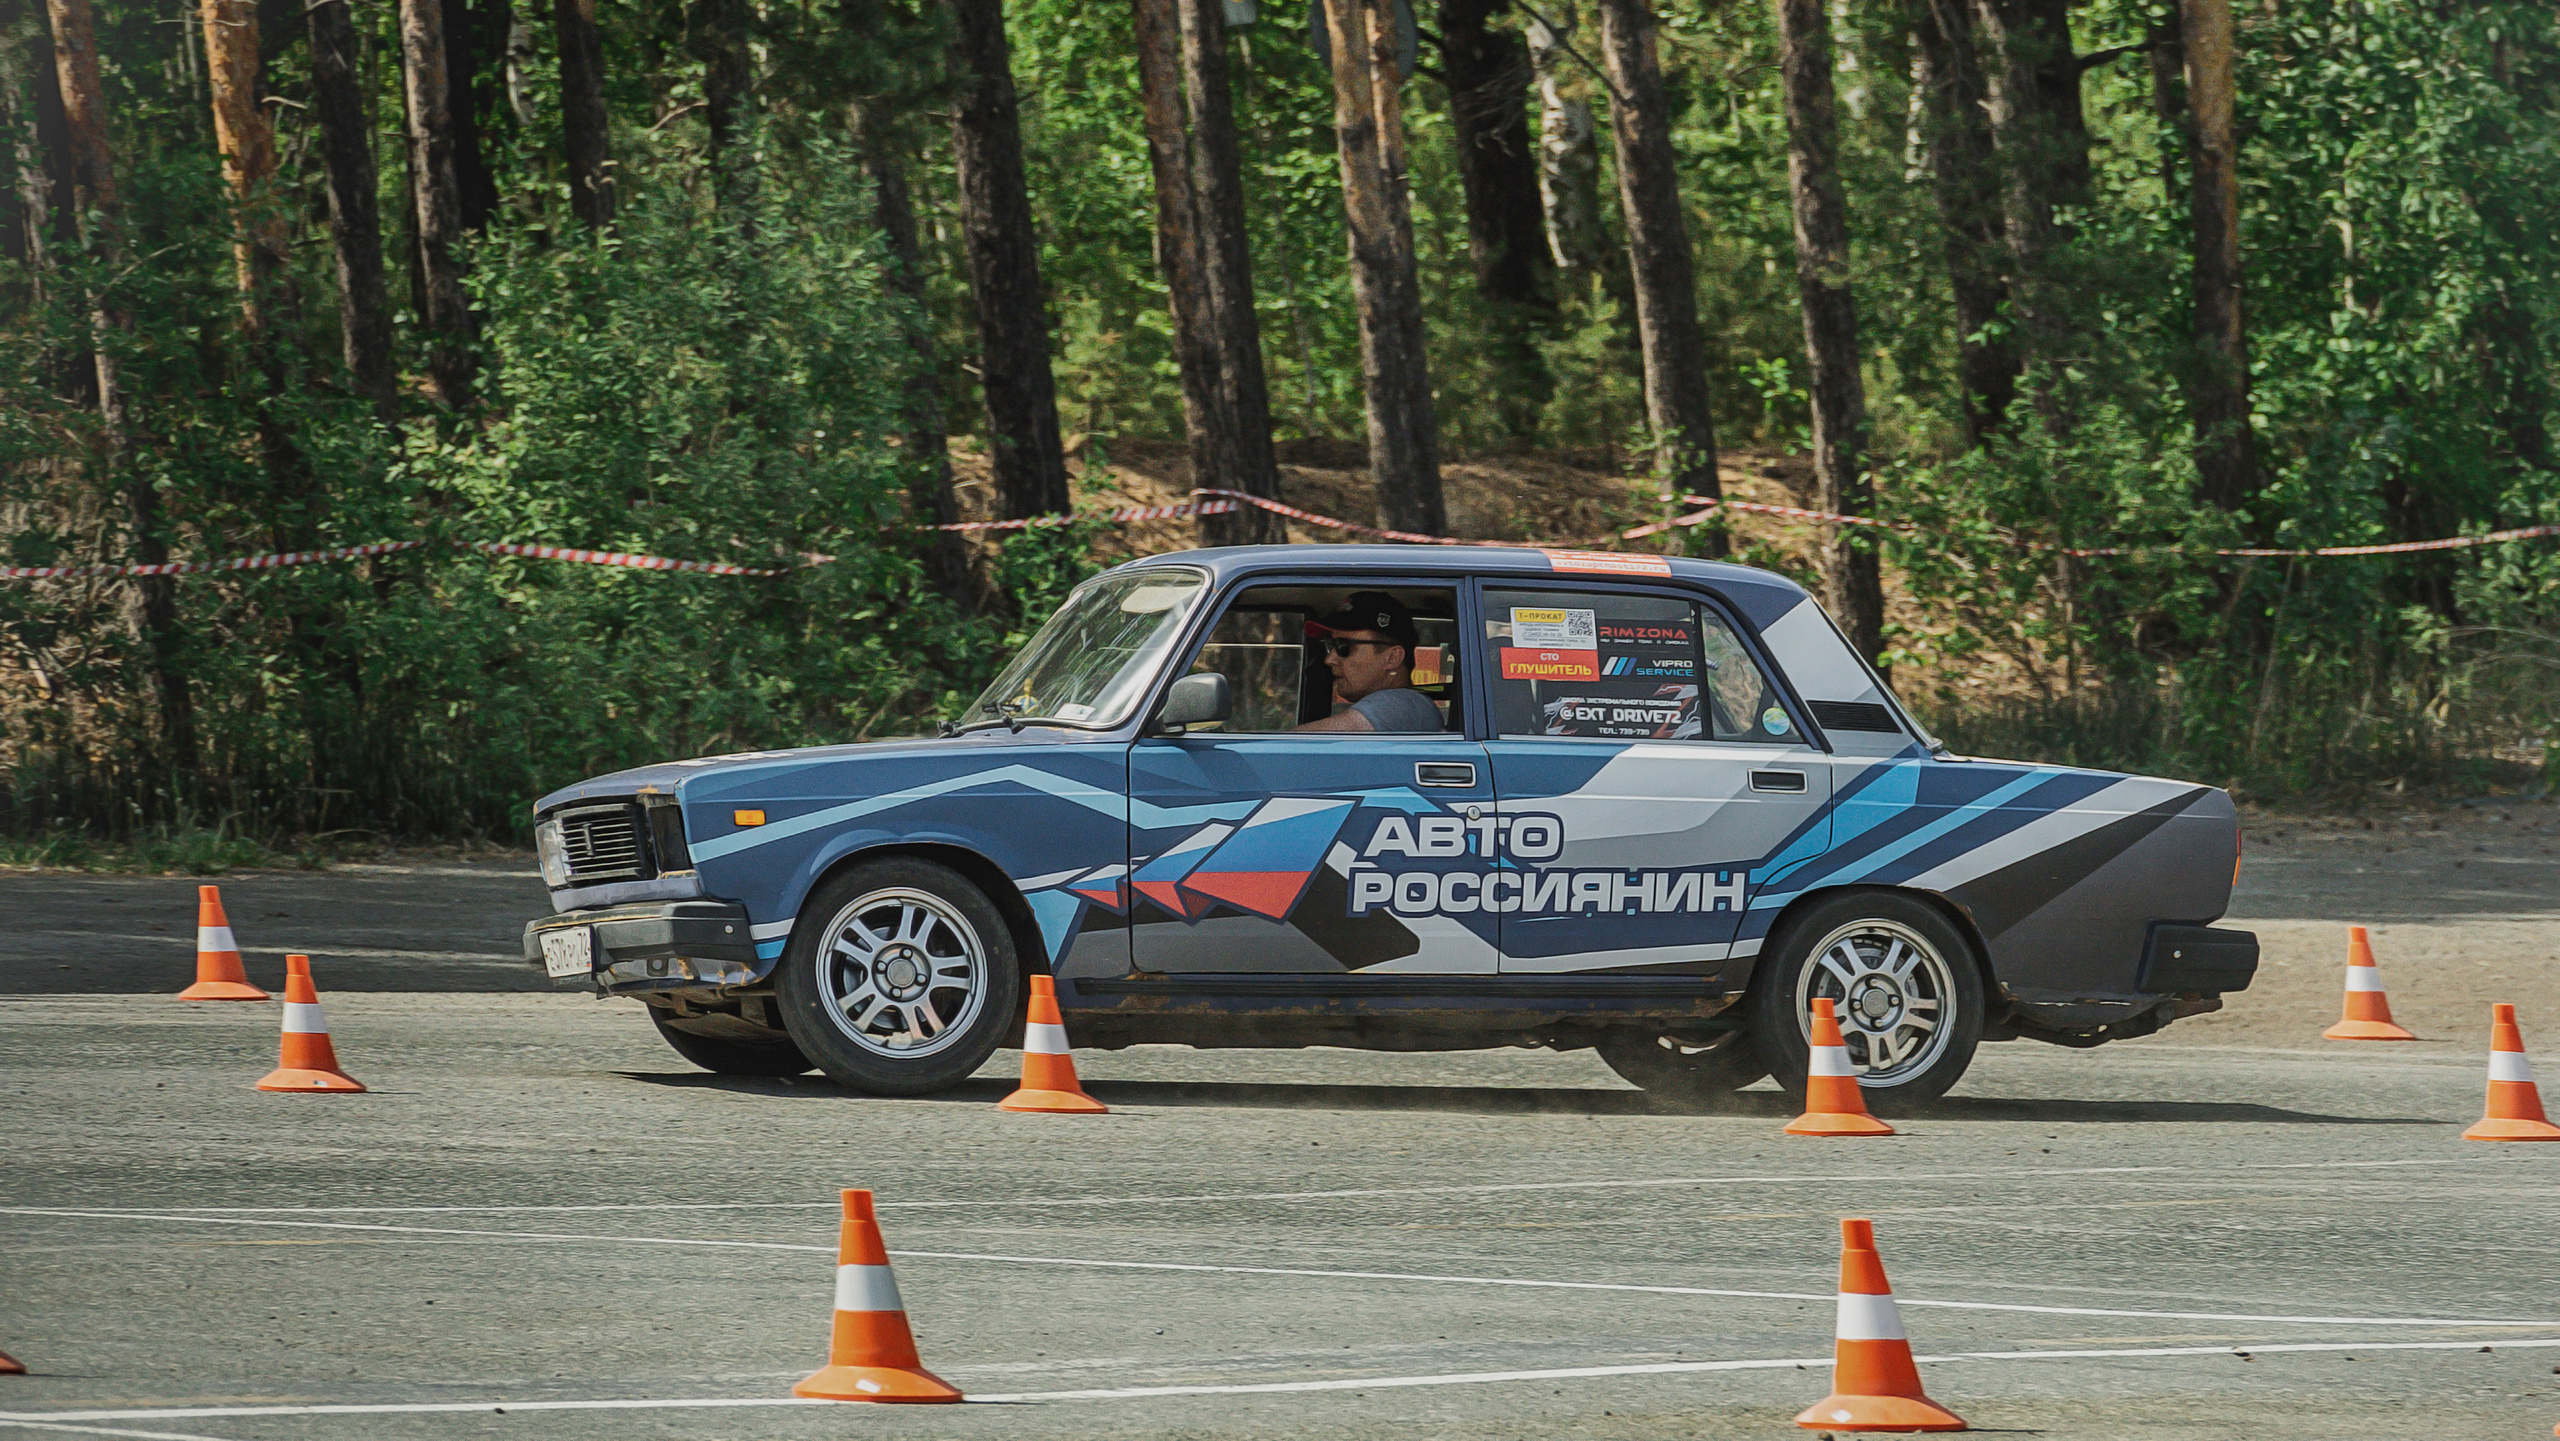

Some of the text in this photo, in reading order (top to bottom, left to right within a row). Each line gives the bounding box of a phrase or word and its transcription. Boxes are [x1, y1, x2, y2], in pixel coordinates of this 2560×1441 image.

[1518, 612, 1563, 620] Т-ПРОКАТ
[1599, 626, 1688, 639] RIMZONA
[1540, 653, 1559, 661] СТО
[1652, 659, 1693, 668] VIPRO
[1510, 663, 1592, 676] ГЛУШИТЕЛЬ
[1636, 668, 1694, 677] SERVICE
[1363, 815, 1561, 858] АВТО
[1352, 871, 1745, 913] РОССИЯНИН
